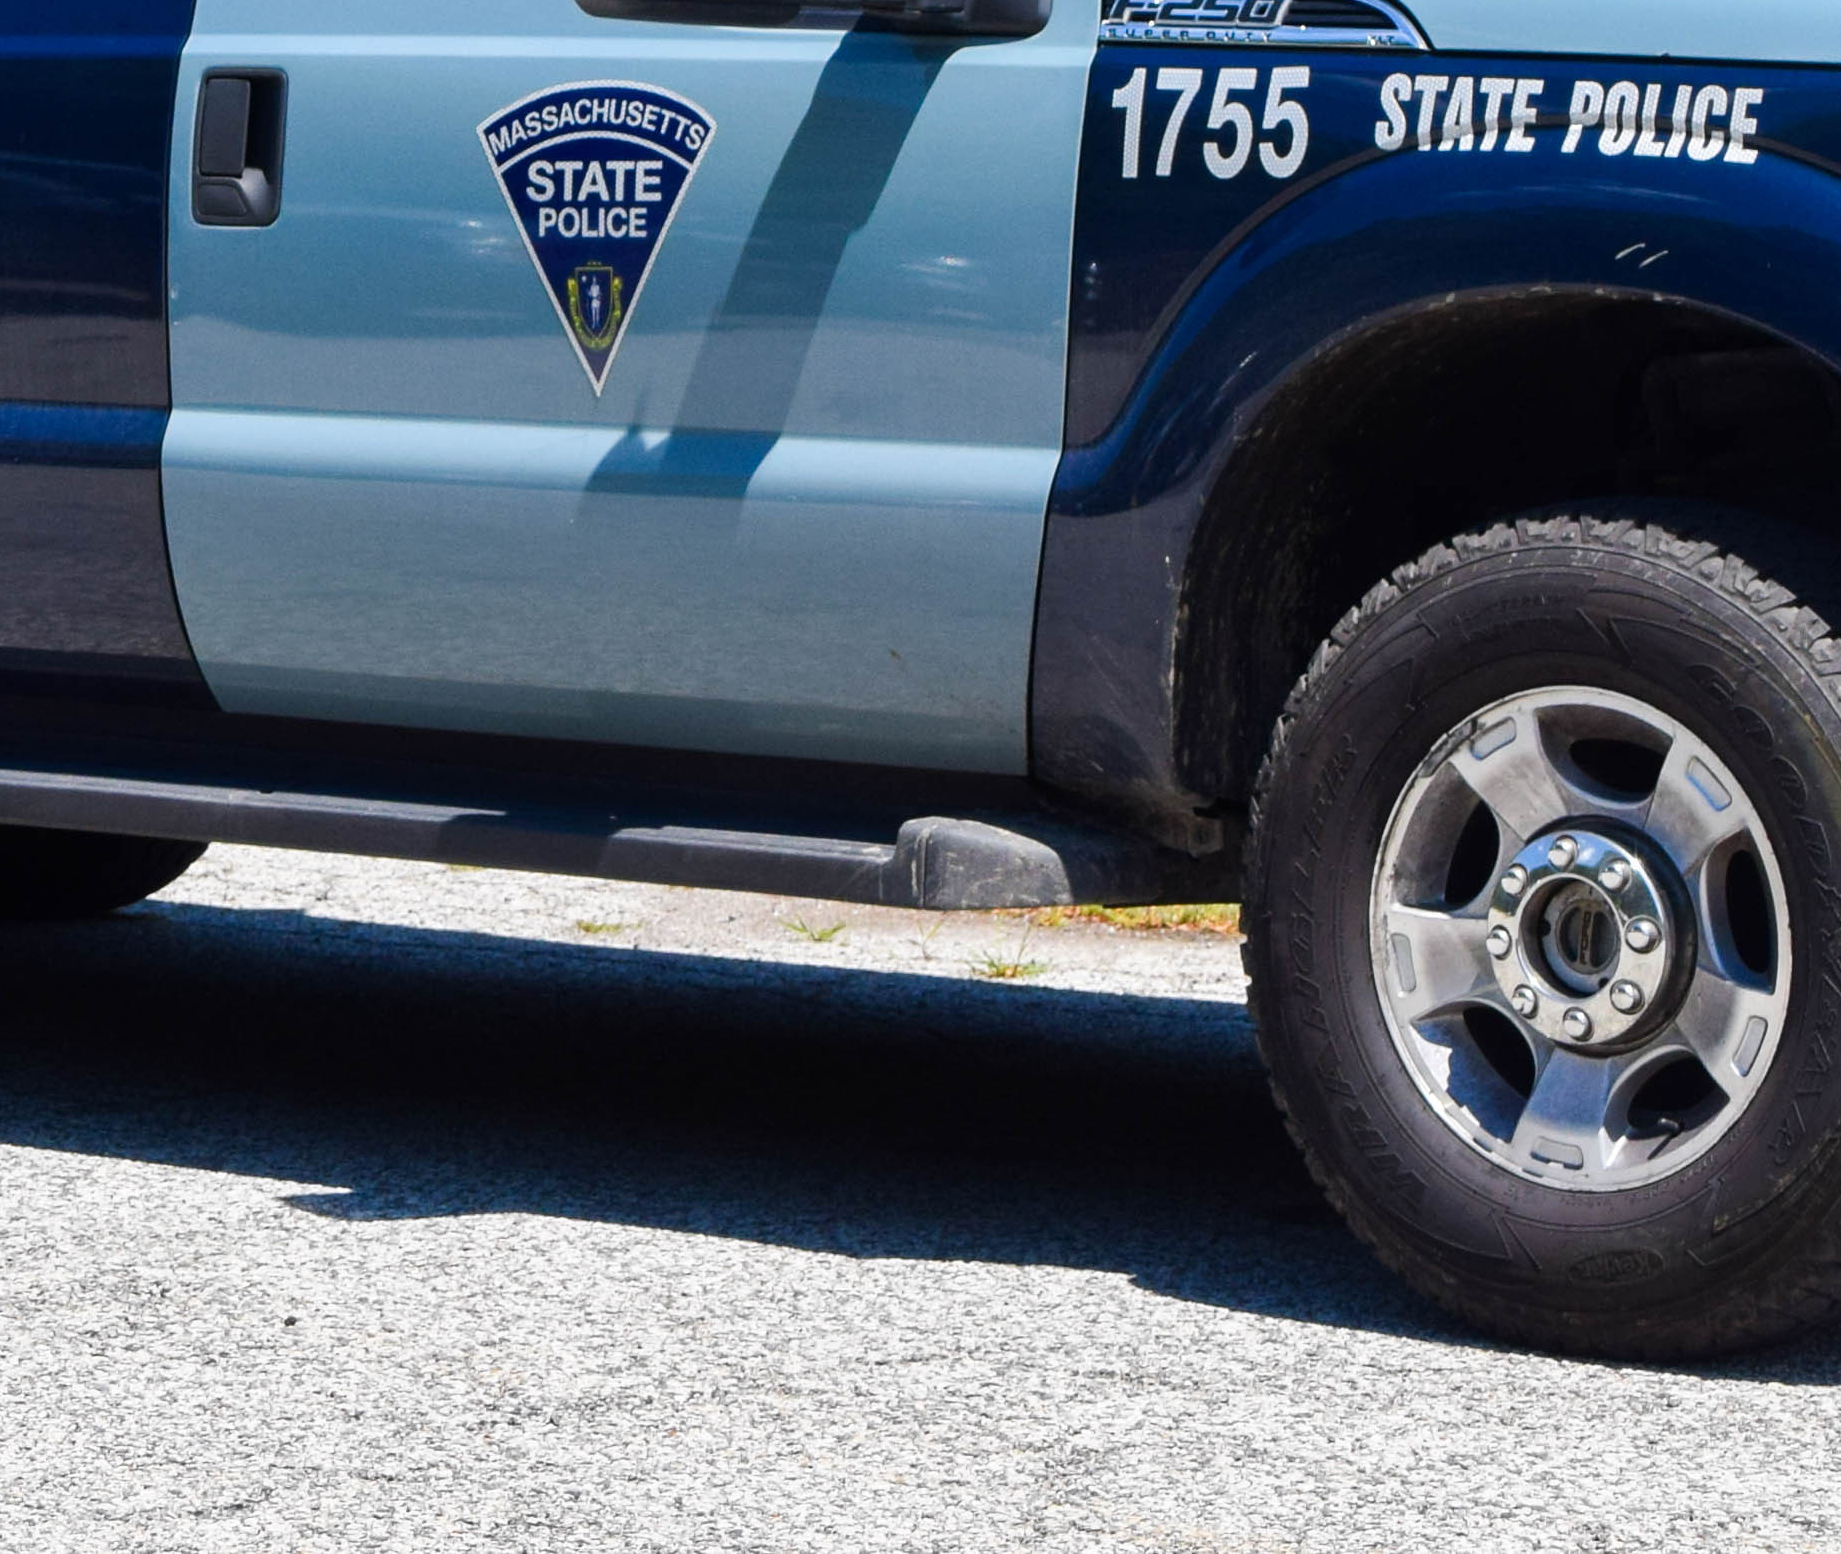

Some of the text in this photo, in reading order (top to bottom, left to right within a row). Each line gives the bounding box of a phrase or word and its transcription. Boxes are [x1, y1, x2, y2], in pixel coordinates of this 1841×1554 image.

[487, 98, 706, 155] MASSACHUSETTS
[1112, 66, 1311, 180] 1755
[1374, 73, 1763, 165] STATE POLICE
[526, 160, 663, 203] STATE
[538, 207, 648, 238] POLICE
